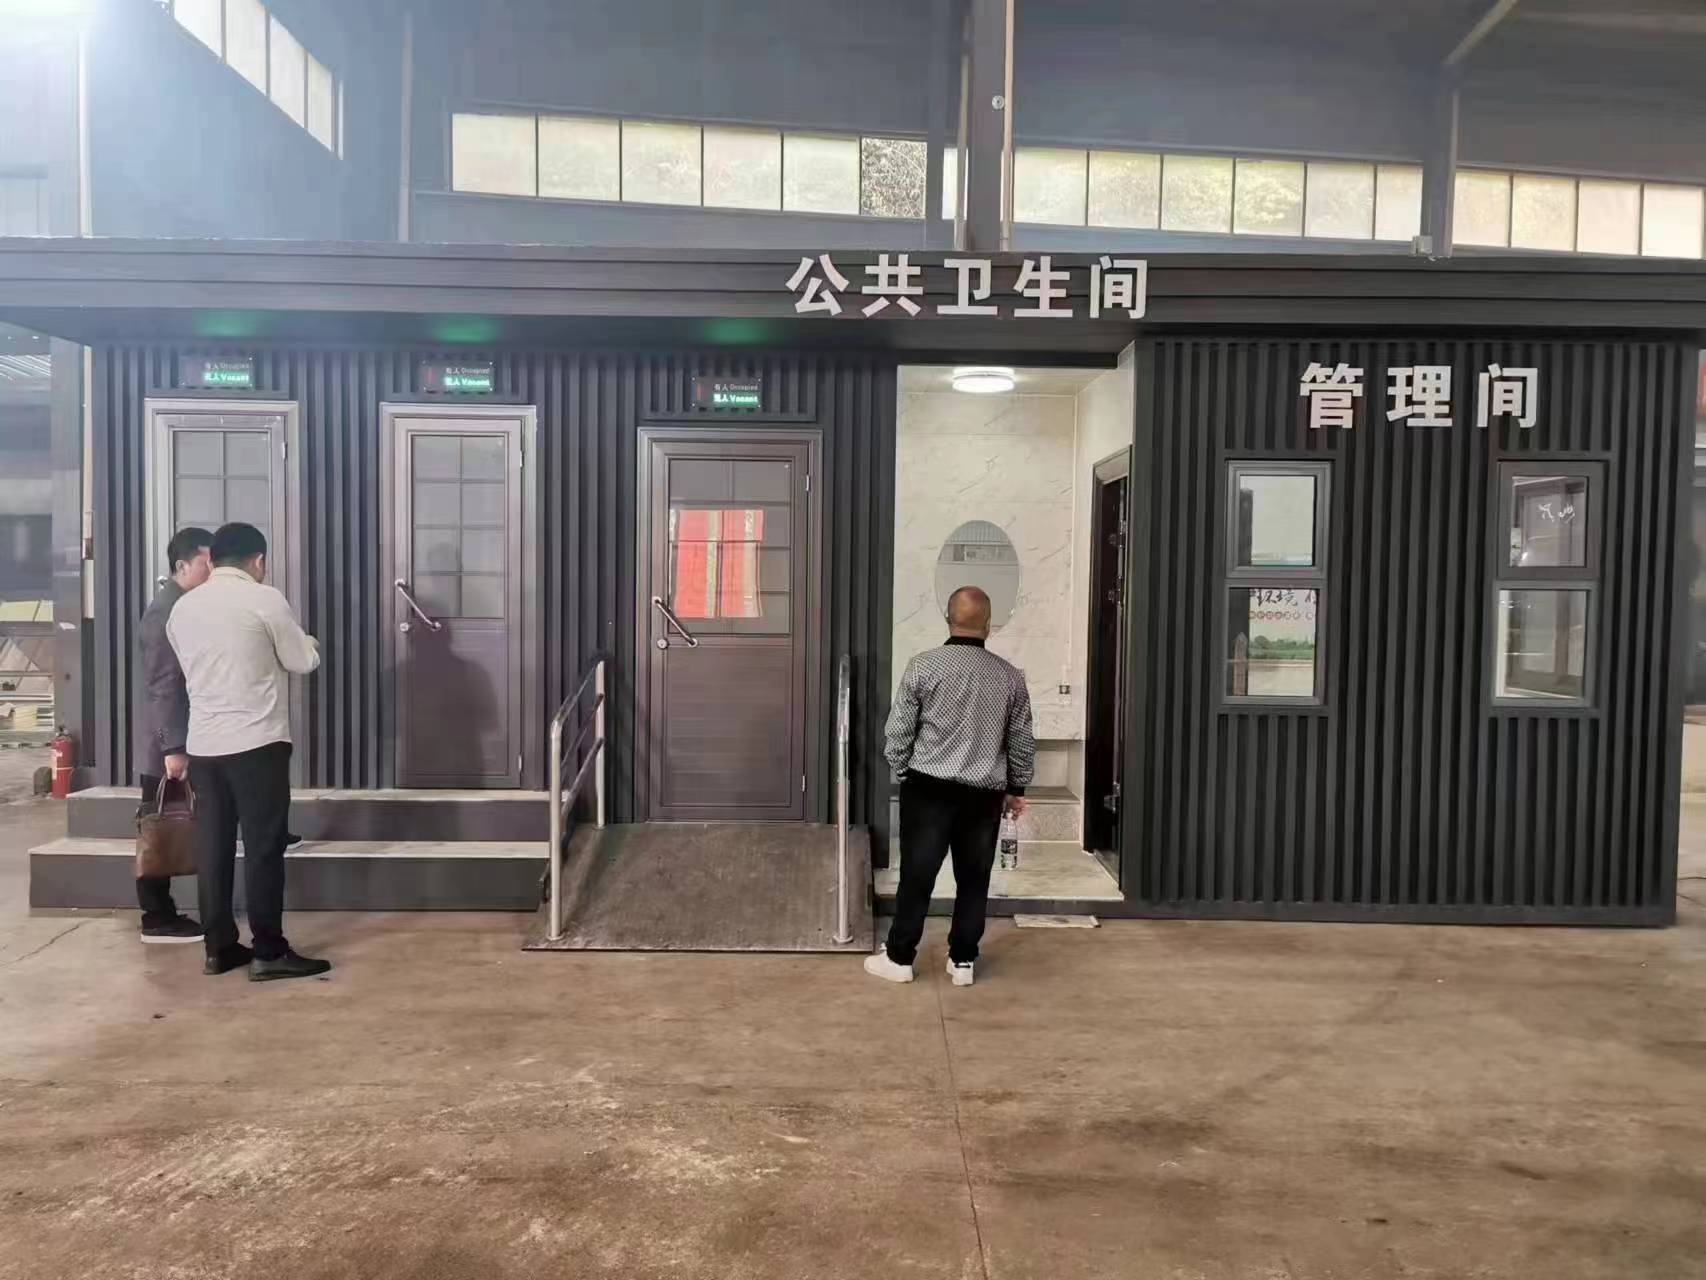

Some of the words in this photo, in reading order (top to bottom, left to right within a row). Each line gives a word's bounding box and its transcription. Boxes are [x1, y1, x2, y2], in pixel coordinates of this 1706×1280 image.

[785, 253, 1148, 319] 公共卫生间
[730, 394, 758, 402] Vacant
[1300, 362, 1538, 428] 管理间
